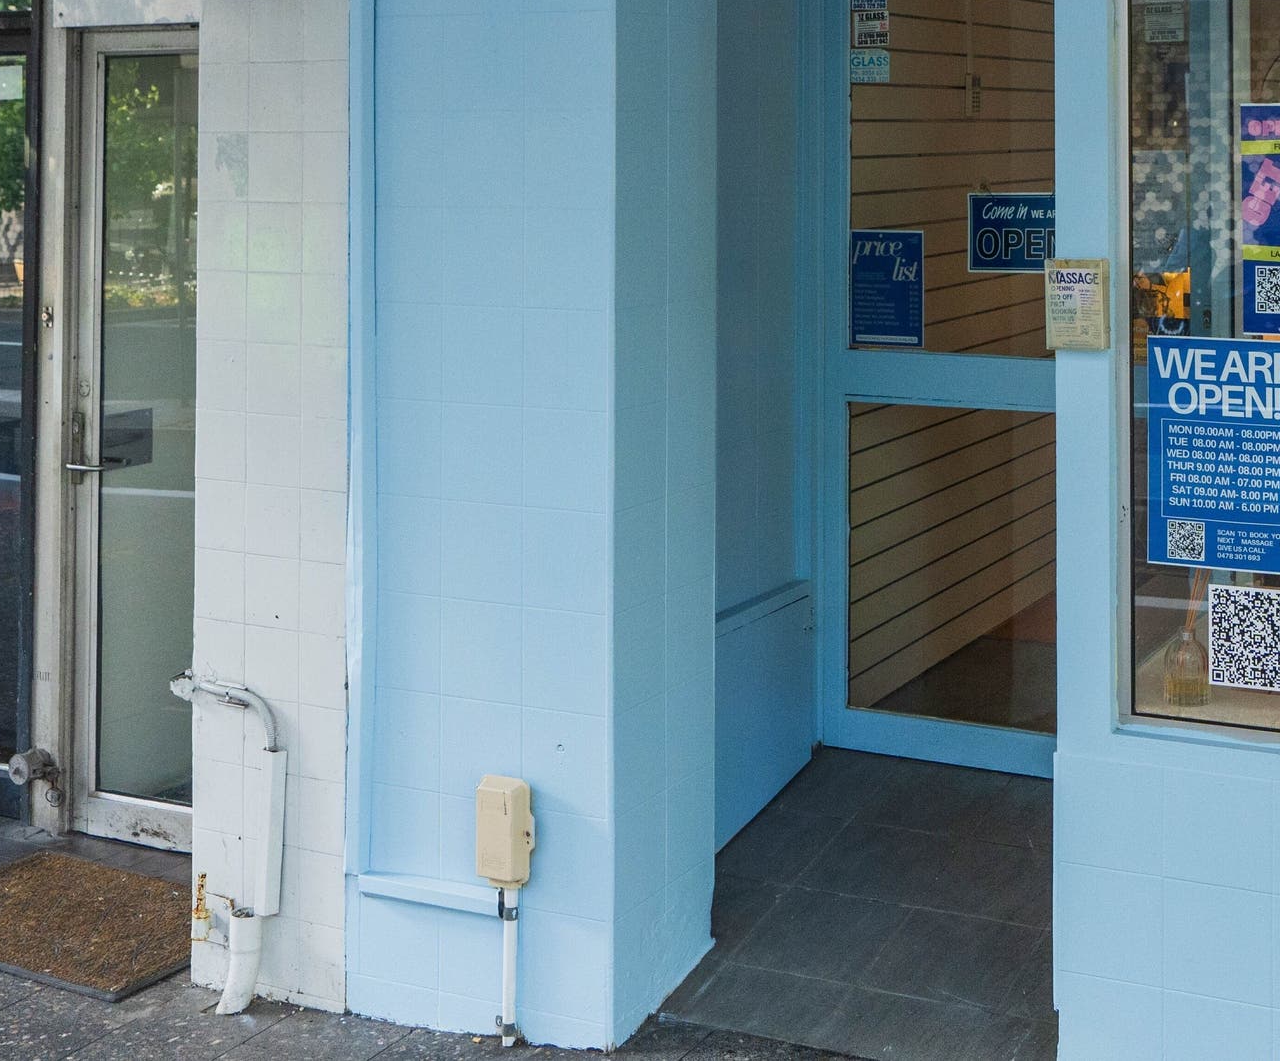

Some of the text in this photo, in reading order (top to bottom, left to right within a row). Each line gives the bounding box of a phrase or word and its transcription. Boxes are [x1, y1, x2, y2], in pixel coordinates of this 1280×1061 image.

[865, 12, 885, 21] GLASS
[852, 57, 888, 67] GLASS
[982, 202, 1044, 219] Come in WE
[853, 234, 903, 264] price
[892, 256, 919, 282] list
[1049, 271, 1099, 284] MASSAGE
[1154, 346, 1217, 380] WE
[1169, 425, 1280, 440] MON 09.00AM 08.00PM
[1168, 437, 1188, 446] TUE
[1192, 439, 1216, 448] 08.00
[1219, 440, 1234, 449] AM
[1167, 449, 1189, 458] WED
[1192, 451, 1216, 460] 08.00
[1238, 453, 1262, 463] 08.00
[1265, 455, 1280, 465] PM
[1167, 461, 1195, 471] THUR
[1197, 463, 1215, 473] 9.00
[1238, 466, 1262, 476] 08.00
[1265, 468, 1280, 477] PM
[1170, 473, 1280, 489] FRI 08.00 AM 07.00 PM
[1172, 485, 1192, 494] SAT
[1194, 487, 1218, 496] 09.00
[1241, 490, 1260, 500] 8.00
[1262, 492, 1278, 501] PM
[1169, 497, 1279, 514] SUN 10.00 AM 6.00 PM
[1250, 531, 1269, 539] BOOK
